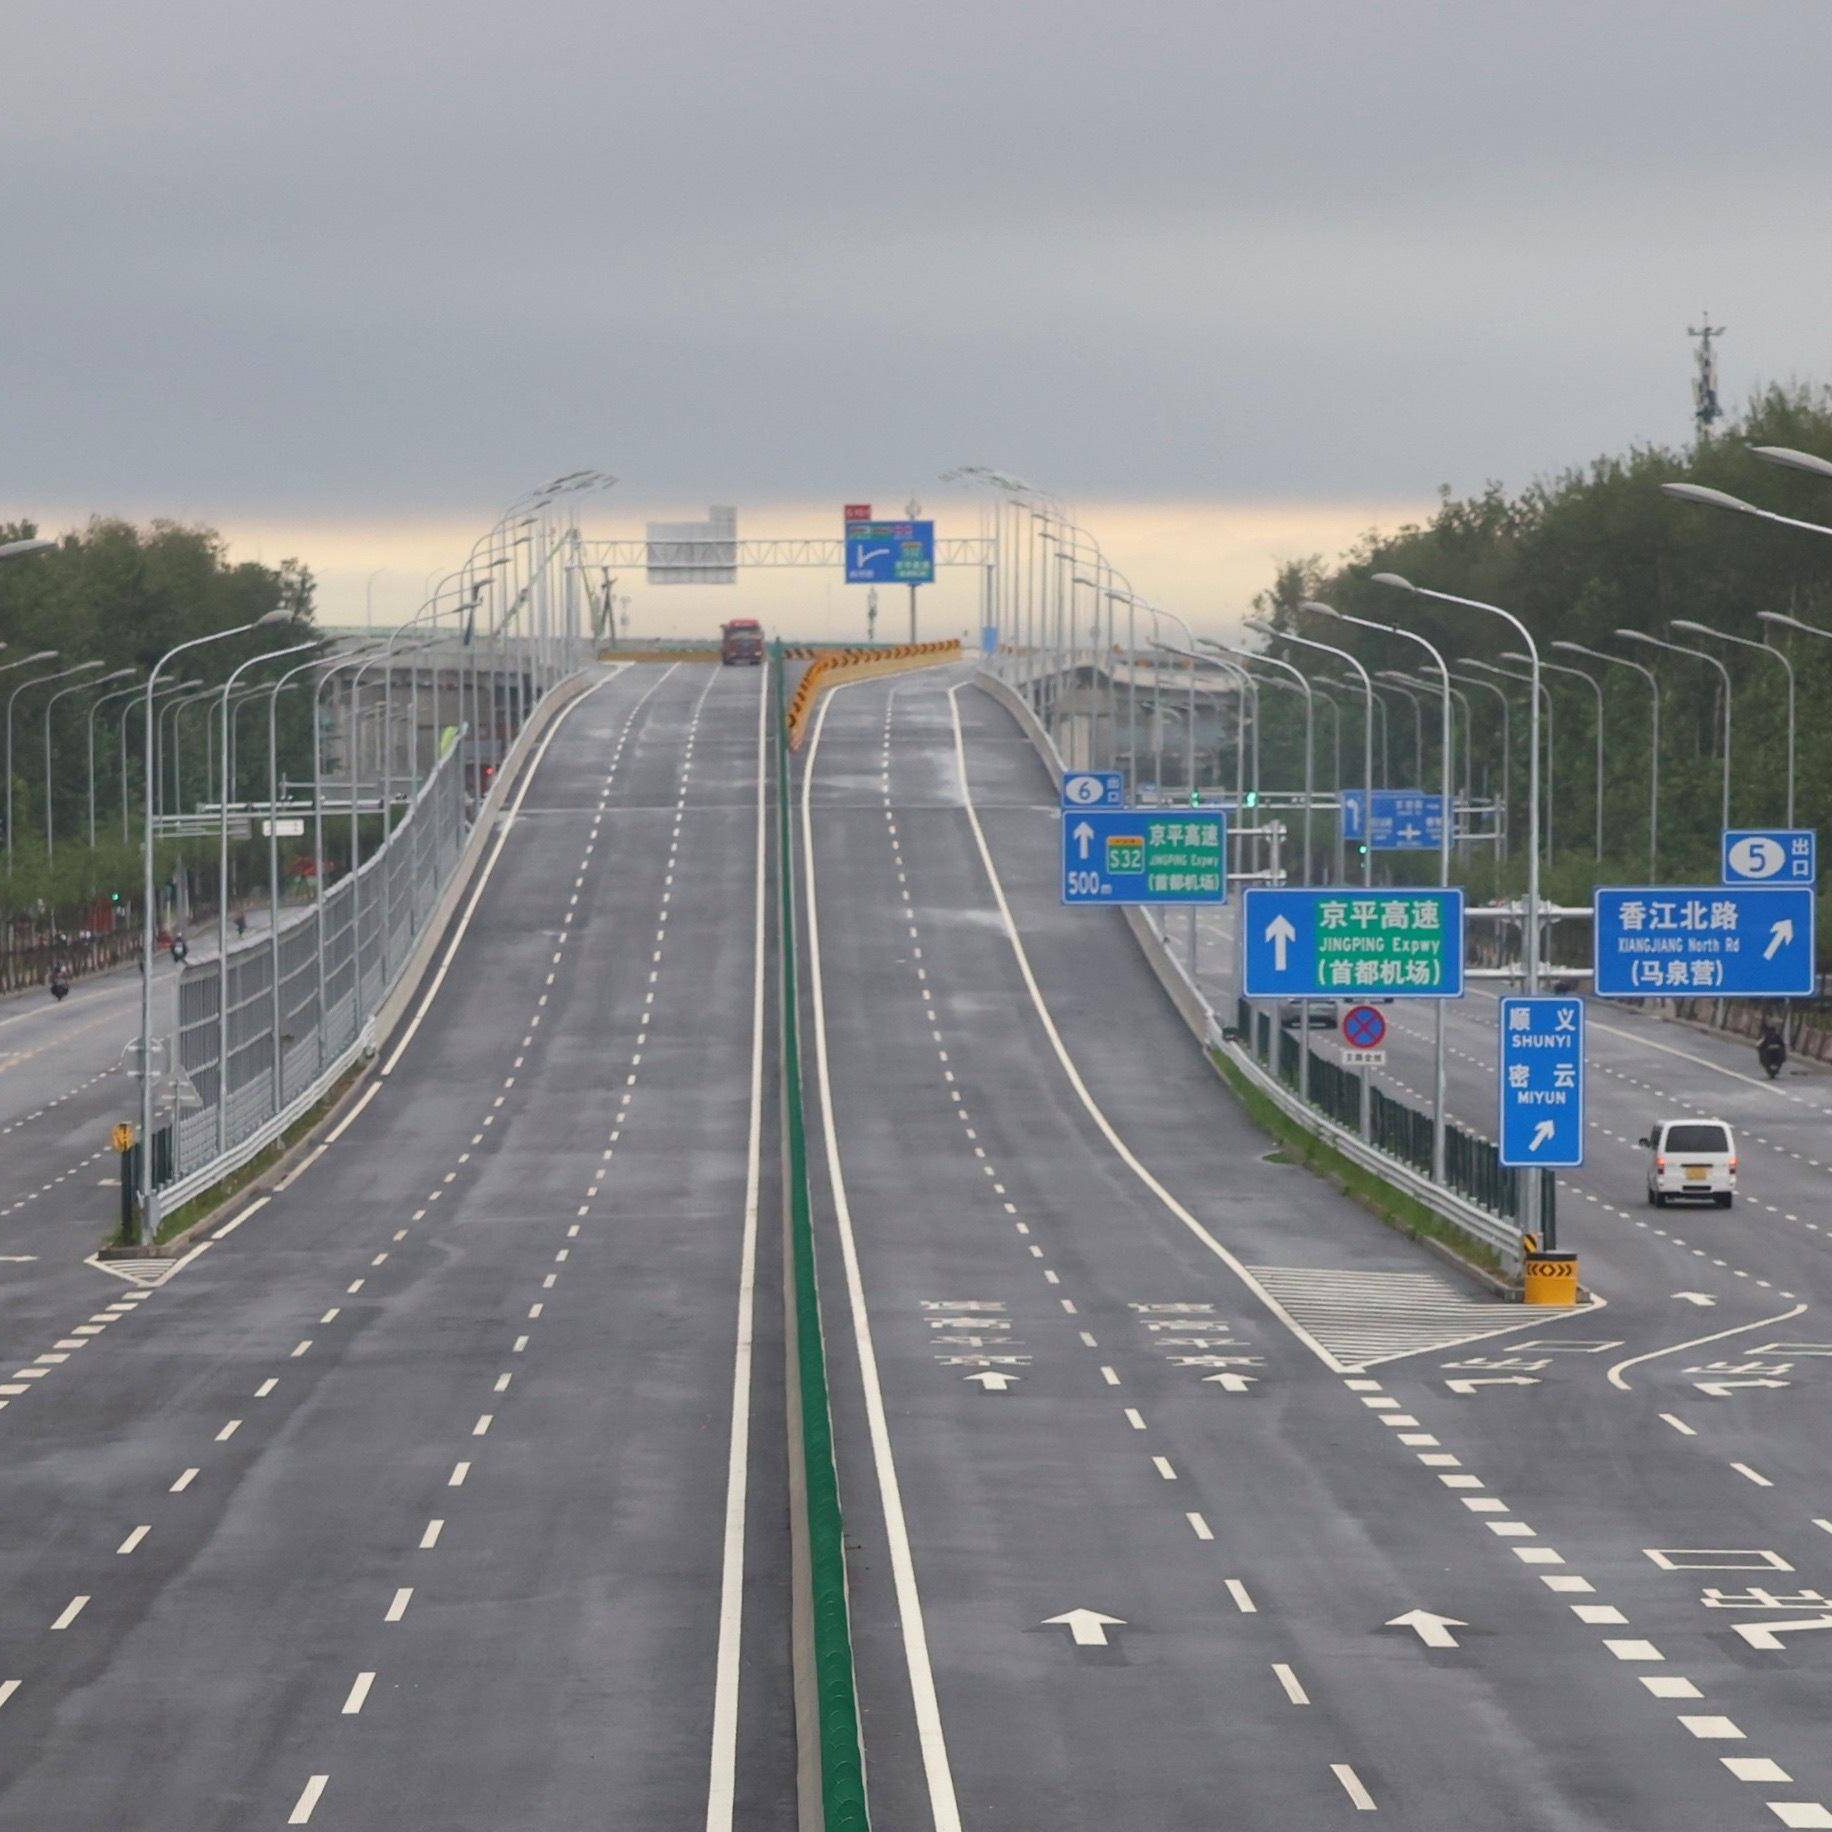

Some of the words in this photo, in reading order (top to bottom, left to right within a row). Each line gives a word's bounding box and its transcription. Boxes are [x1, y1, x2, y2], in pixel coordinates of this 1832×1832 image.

[1078, 781, 1091, 800] 6
[1149, 823, 1220, 846] 京平高速
[1110, 850, 1141, 868] S32
[1749, 845, 1765, 872] 5
[1791, 838, 1810, 877] 出口
[1320, 900, 1440, 930] 京平高速
[1618, 900, 1739, 931] 香江北路
[1320, 936, 1385, 952] JINGPING
[1392, 936, 1441, 955] Expwy
[1688, 937, 1720, 953] North
[1725, 937, 1740, 953] Rd
[1318, 959, 1441, 986] (首都机场)
[1631, 959, 1724, 987] (马泉营)
[1511, 1034, 1571, 1048] SHUNYI
[1517, 1090, 1567, 1105] MIYUN
